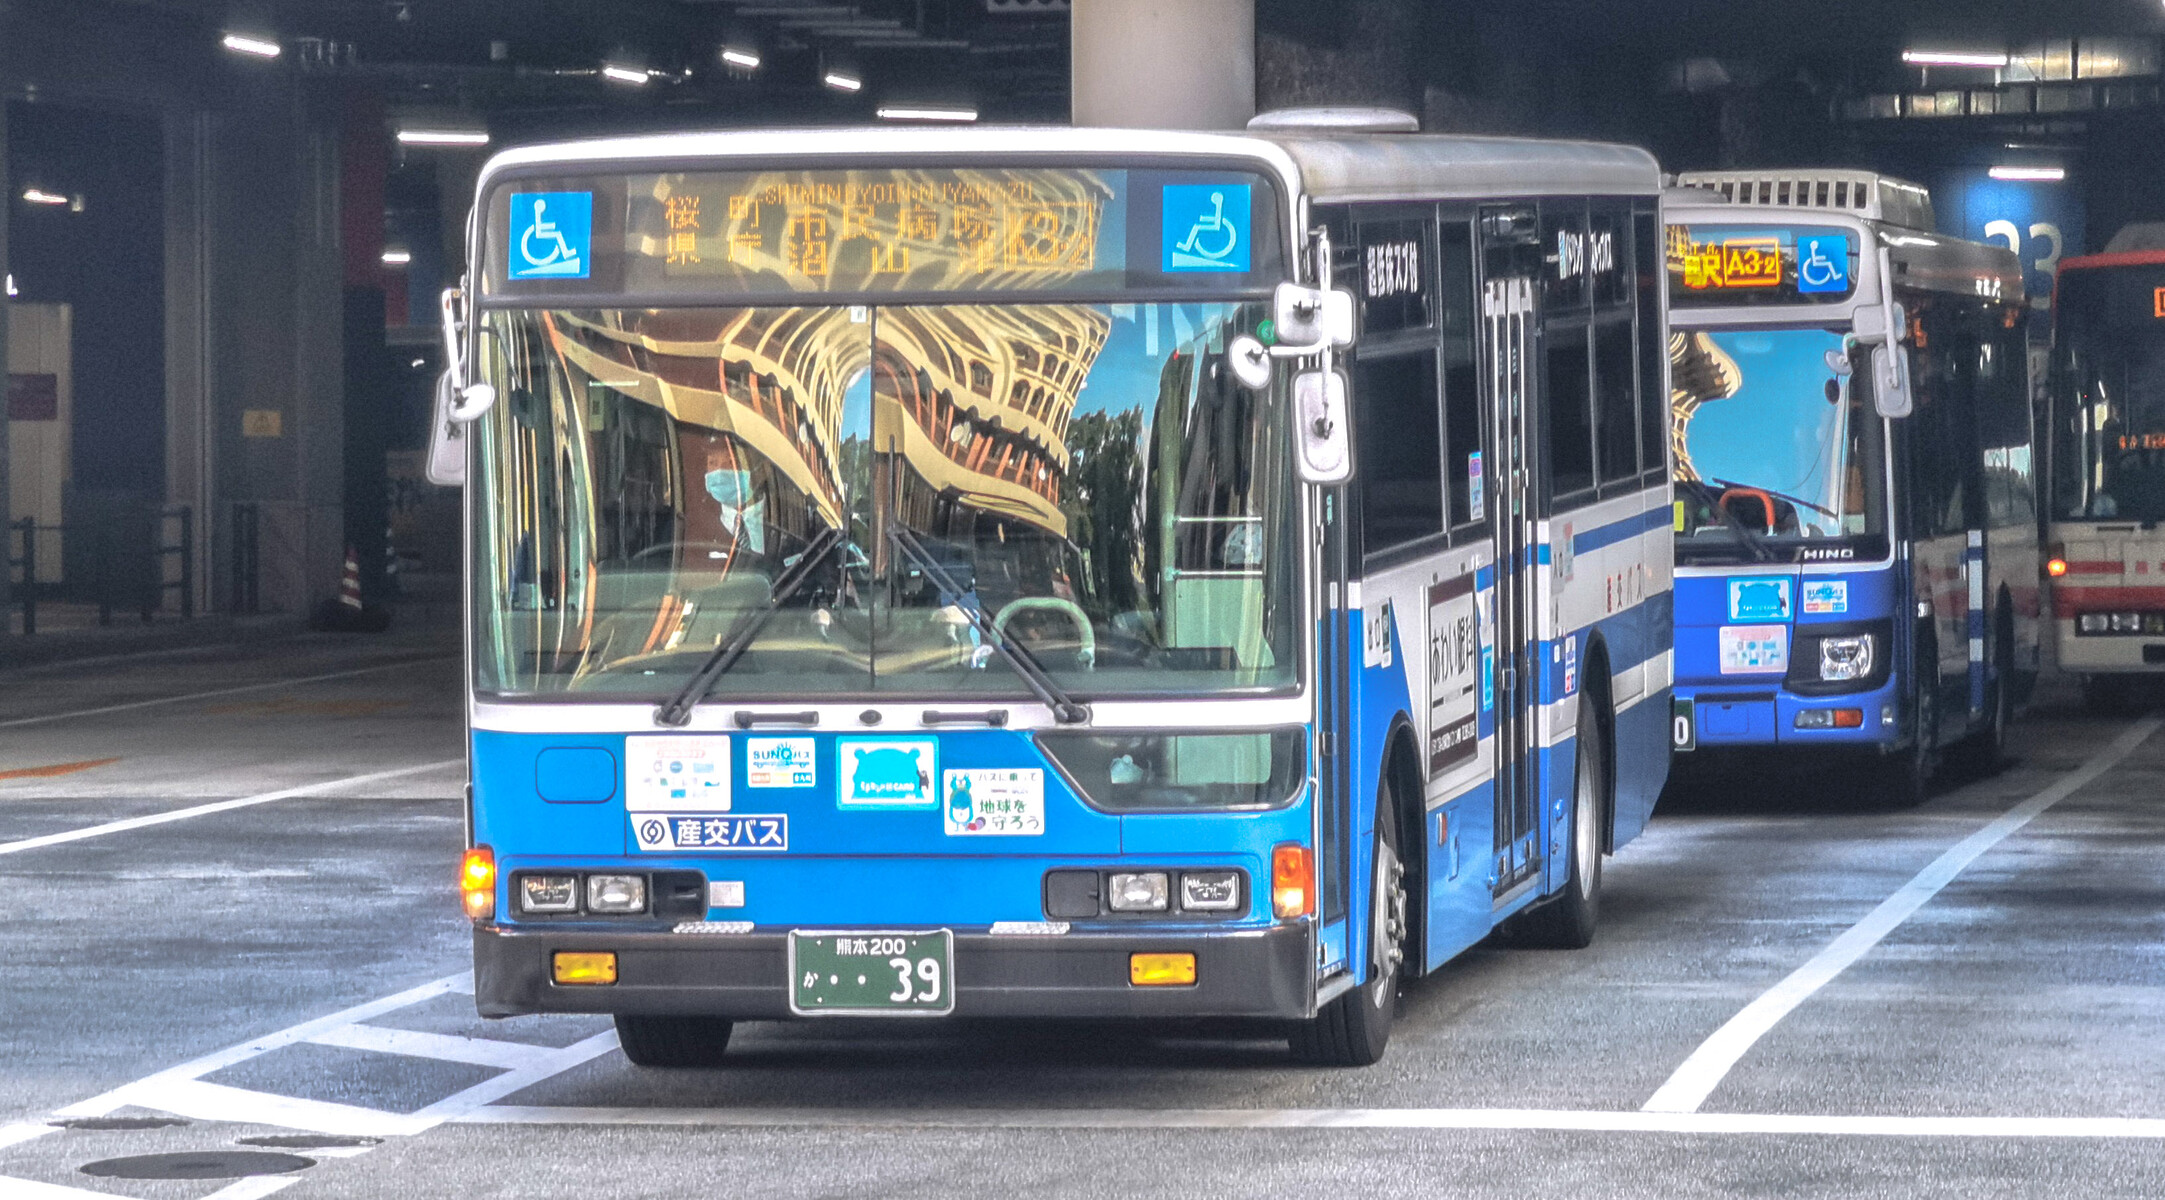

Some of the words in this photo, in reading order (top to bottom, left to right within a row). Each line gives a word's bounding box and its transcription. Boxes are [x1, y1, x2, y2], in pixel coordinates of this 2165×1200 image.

[1803, 549, 1854, 560] HINO
[979, 798, 1027, 815] 地球を
[991, 814, 1040, 831] 守ろう
[677, 819, 783, 845] 産交バス
[803, 971, 819, 989] か
